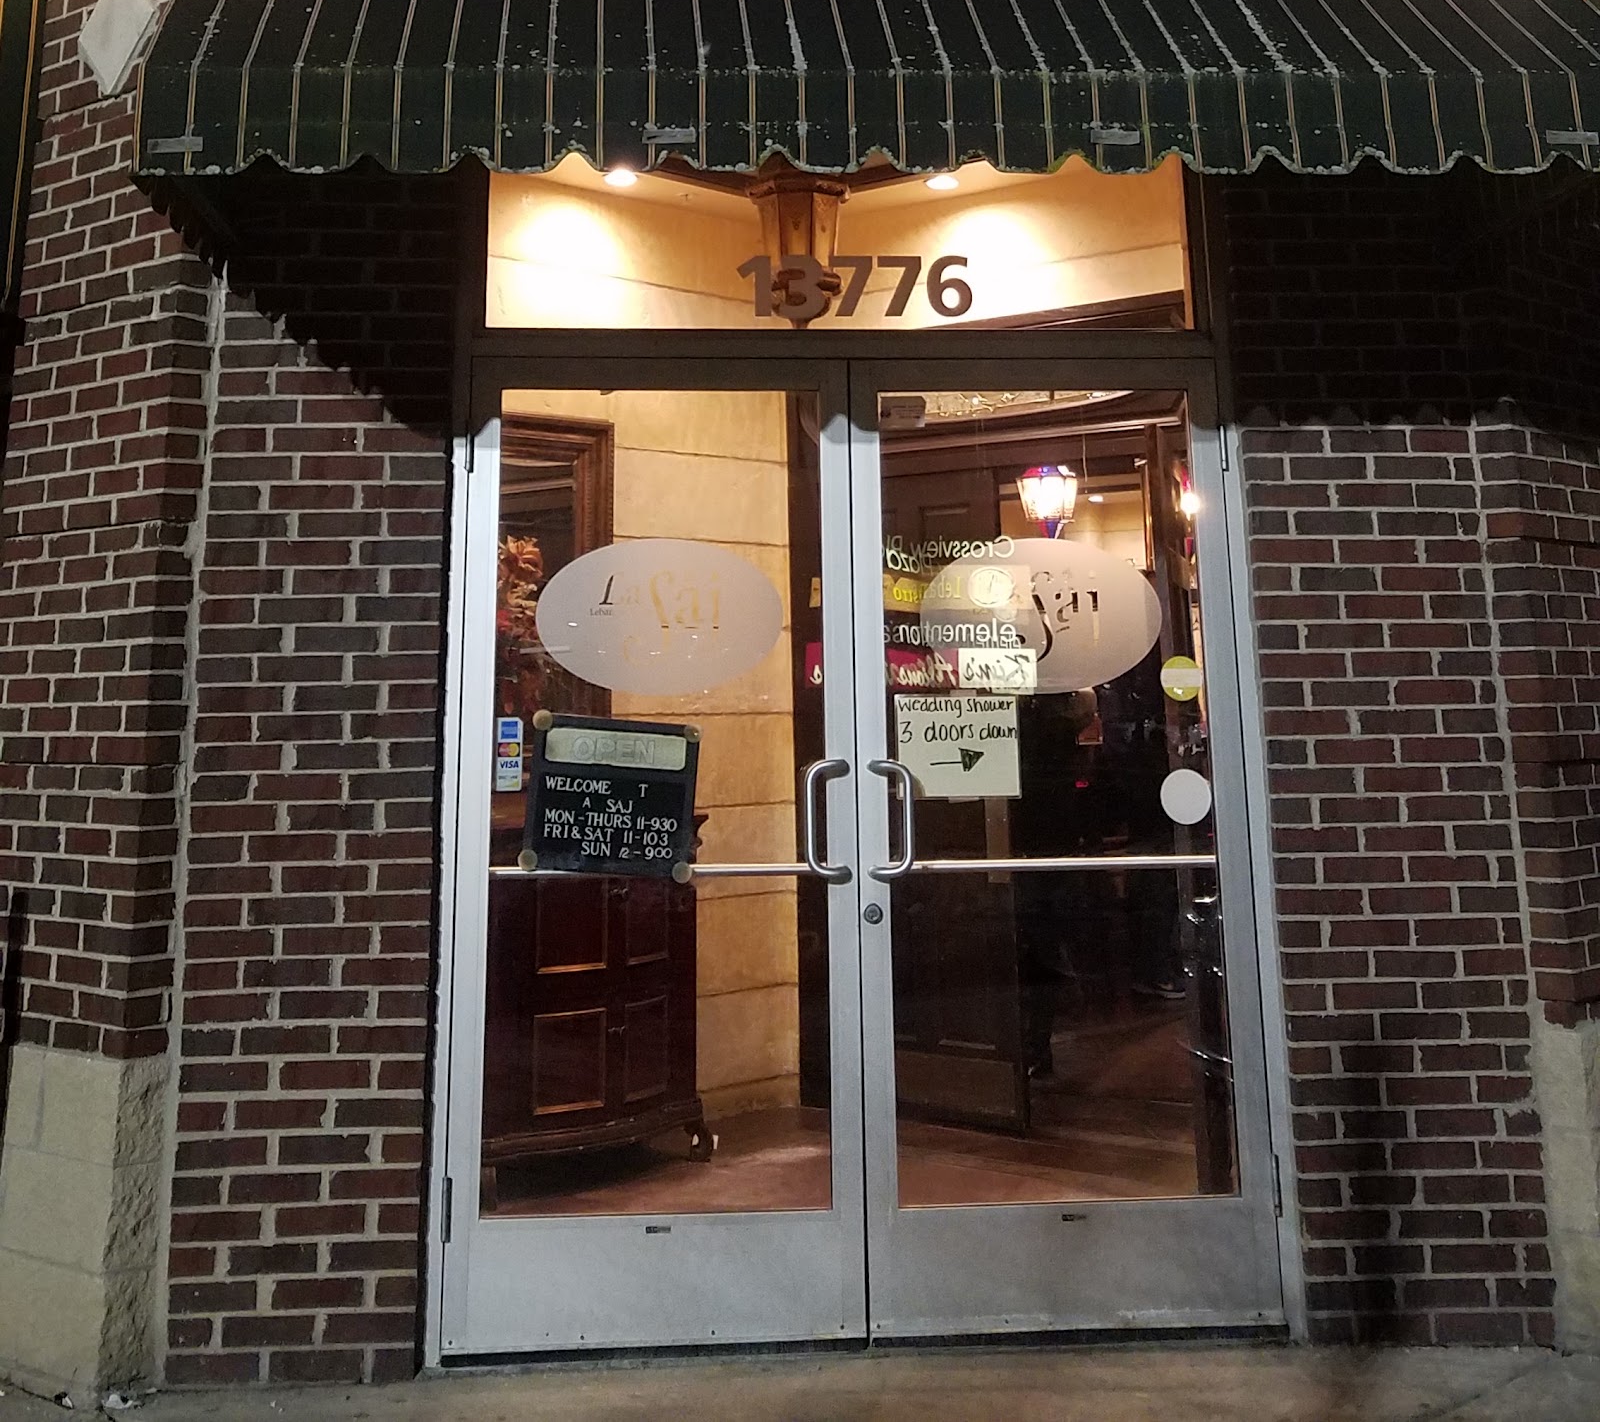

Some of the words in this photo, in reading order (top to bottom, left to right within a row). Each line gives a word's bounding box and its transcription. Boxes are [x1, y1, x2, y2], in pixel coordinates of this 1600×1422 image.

[736, 254, 973, 318] 13776
[899, 721, 913, 744] 3
[924, 721, 974, 743] doors
[573, 736, 656, 765] OPEN
[500, 760, 520, 769] VISA
[545, 776, 612, 795] WELCOME
[638, 783, 649, 798] T
[582, 796, 591, 809] A
[605, 799, 634, 814] SAJ
[580, 841, 611, 857] SUN
